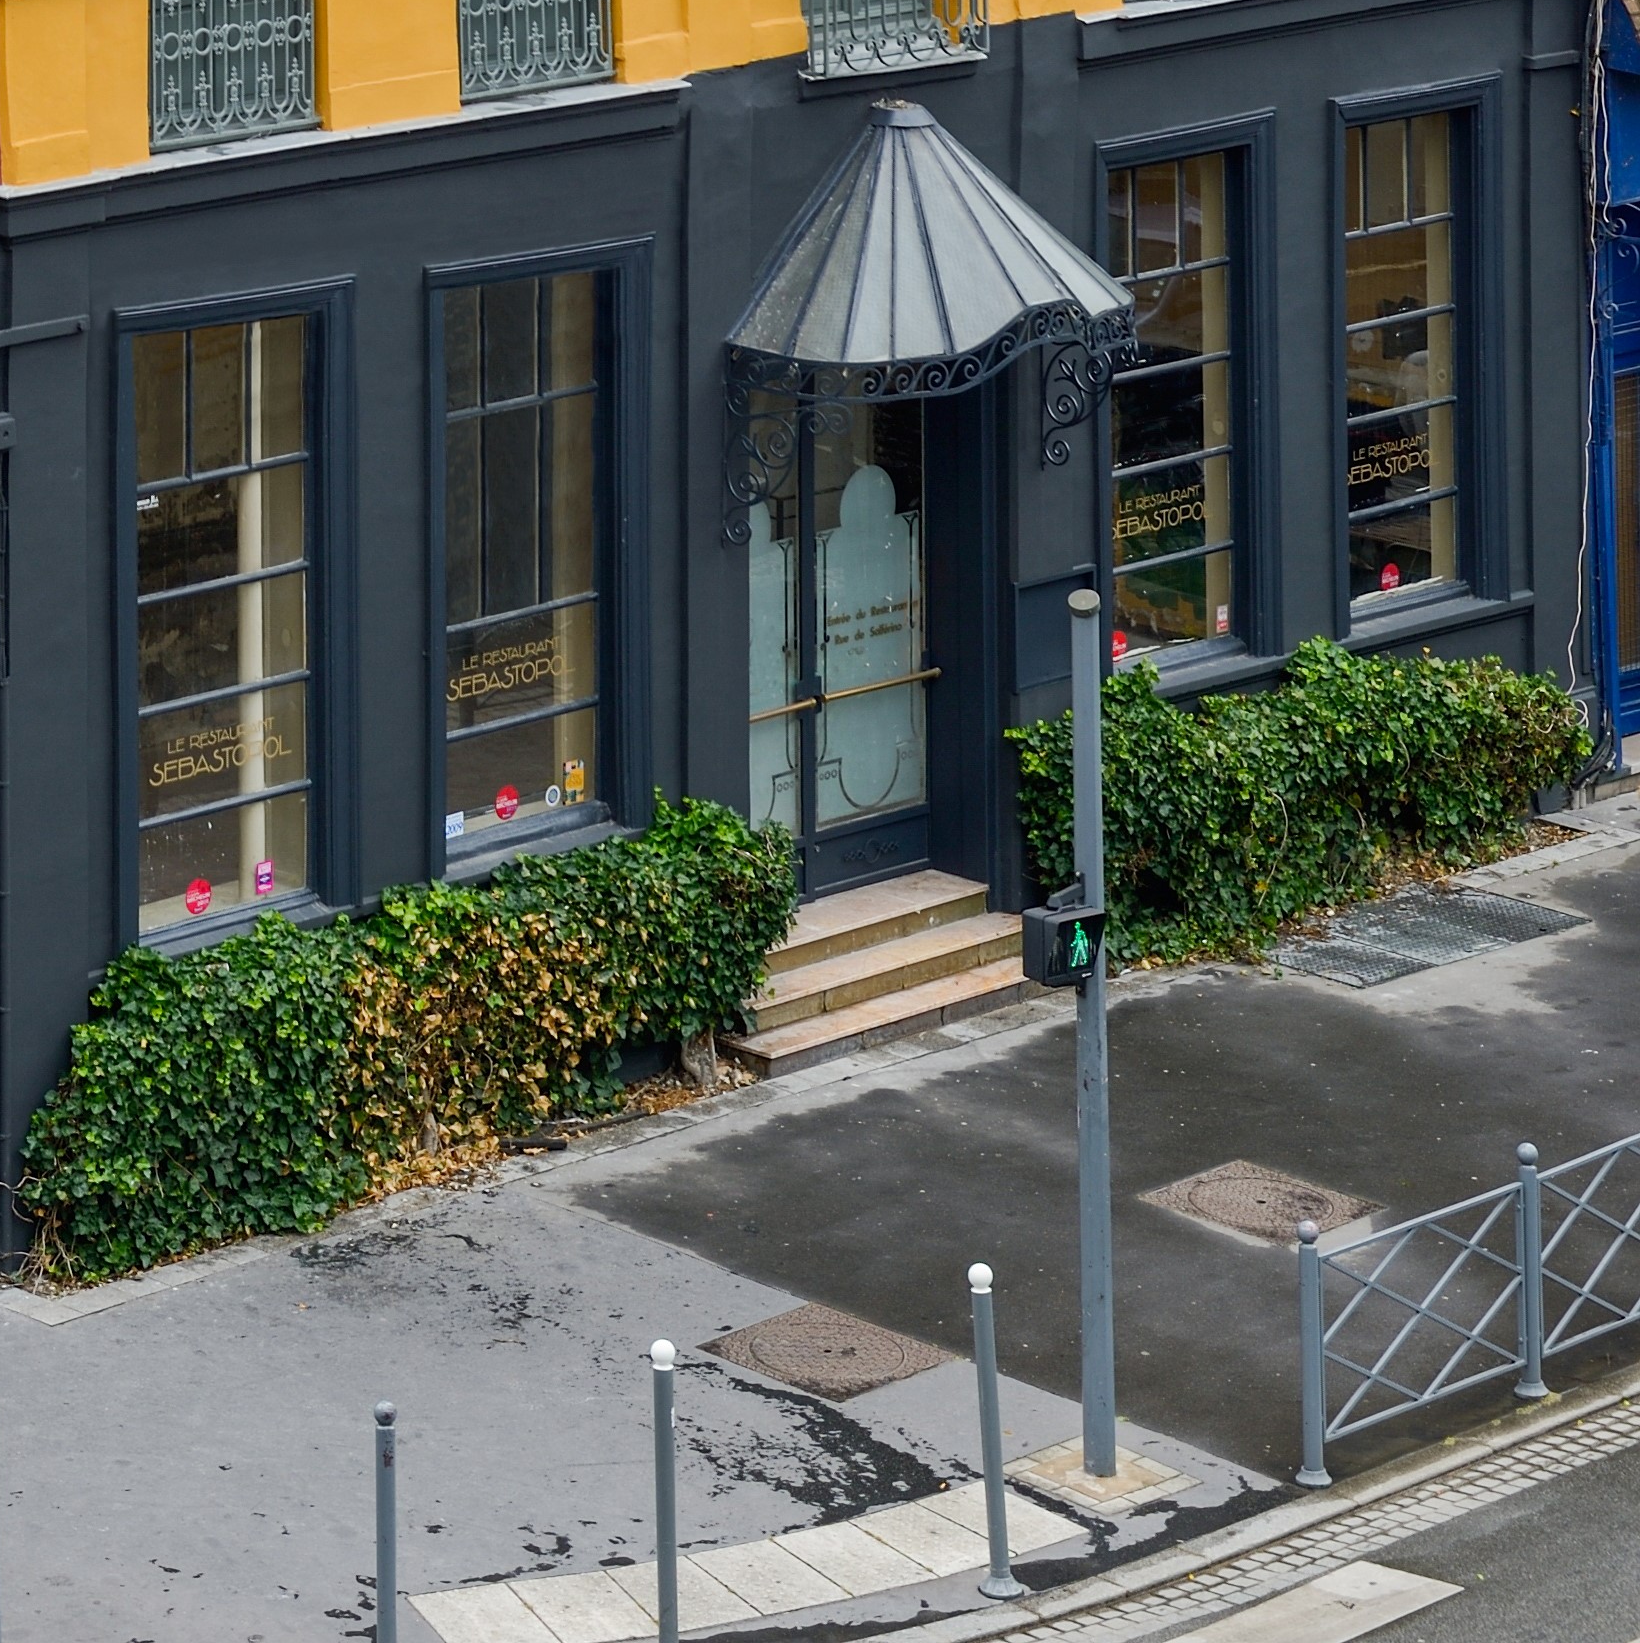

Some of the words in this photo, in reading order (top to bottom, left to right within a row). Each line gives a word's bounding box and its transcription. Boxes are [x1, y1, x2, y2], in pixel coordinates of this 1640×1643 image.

[1353, 448, 1366, 461] LE
[1368, 433, 1428, 458] RESTAURANT
[1119, 500, 1133, 514] LE
[1136, 484, 1201, 511] RESTAURANT
[462, 655, 479, 671] LE
[483, 636, 560, 665] RESTAURANT
[446, 655, 575, 701] SEBASTOPOL
[167, 737, 185, 754] LE
[189, 717, 275, 749] RESTAURANT
[149, 735, 292, 786] SEBASTOPOL
